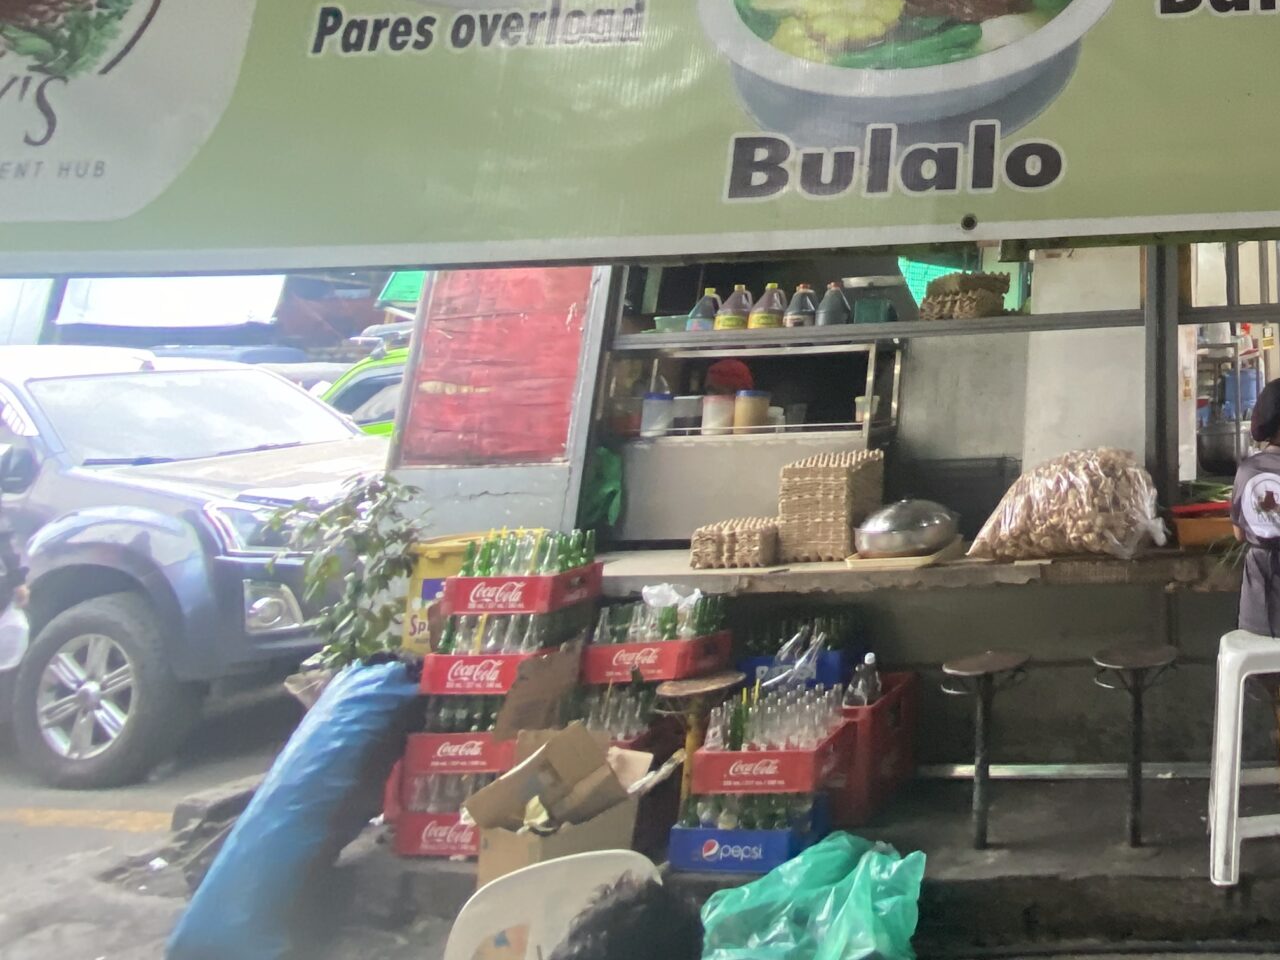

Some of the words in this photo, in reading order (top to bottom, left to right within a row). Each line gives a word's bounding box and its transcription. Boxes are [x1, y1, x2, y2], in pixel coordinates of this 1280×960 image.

[311, 6, 437, 53] Pares
[57, 160, 105, 178] HUB
[727, 121, 1062, 198] Bulalo
[719, 844, 763, 861] pepsi
